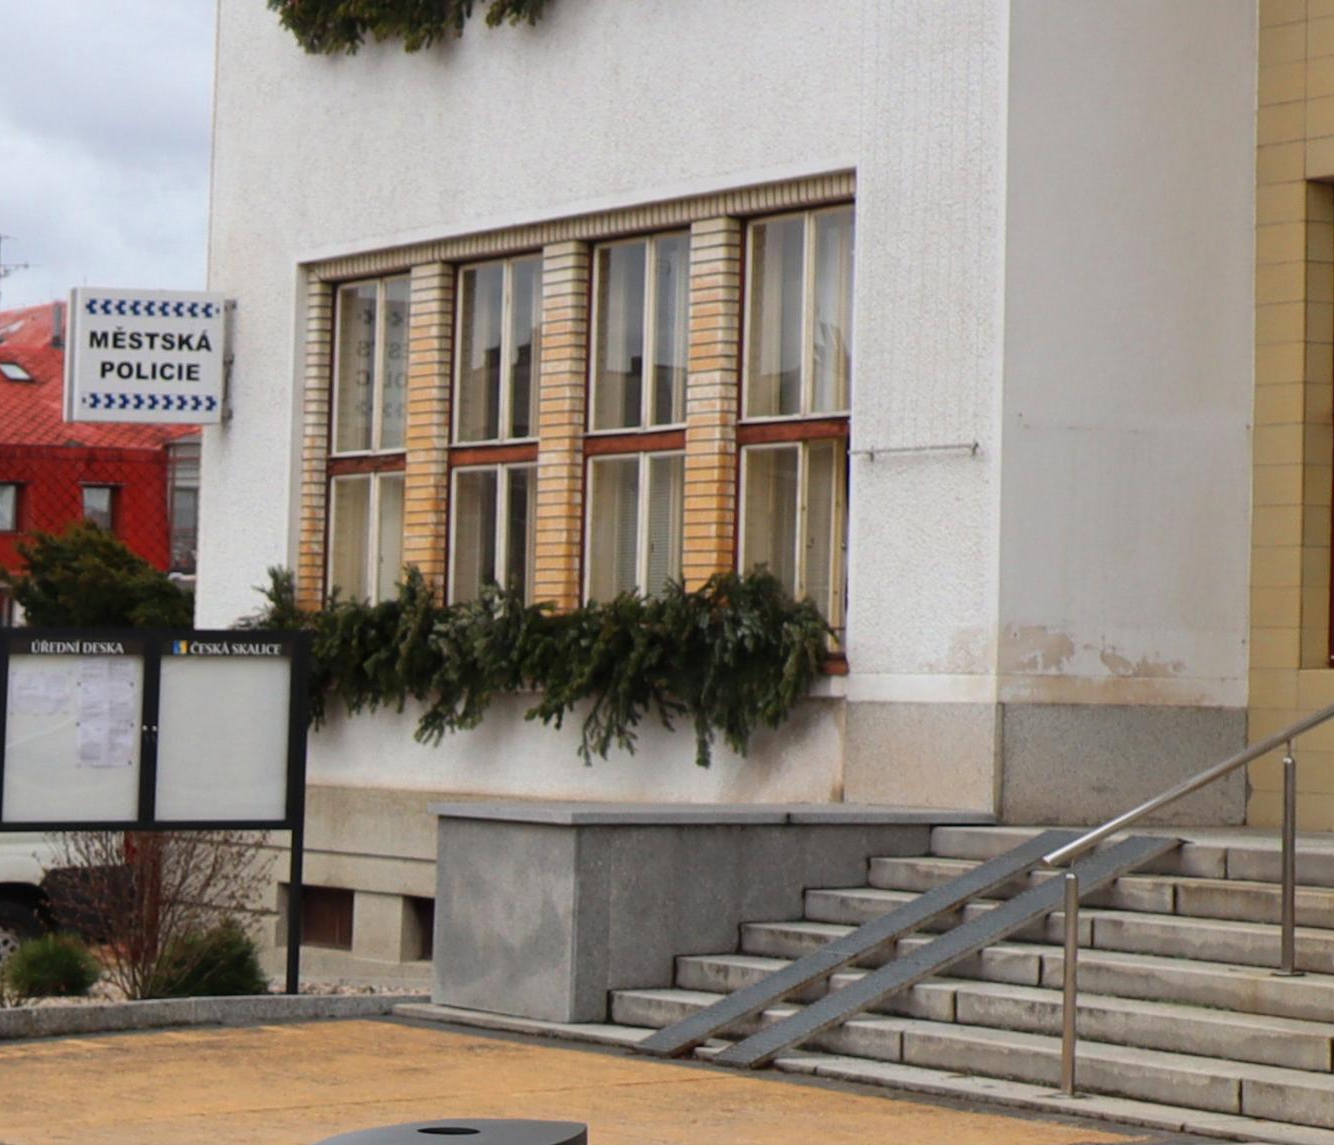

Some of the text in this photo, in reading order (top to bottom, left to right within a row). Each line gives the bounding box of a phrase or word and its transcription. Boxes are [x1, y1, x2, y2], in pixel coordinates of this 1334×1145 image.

[88, 326, 212, 352] MĚSTSKÁ
[100, 361, 200, 381] POLICIE
[31, 639, 125, 654] ÚŘEDNÍ DESKA
[190, 641, 282, 656] ČESKÁ SKALICE
